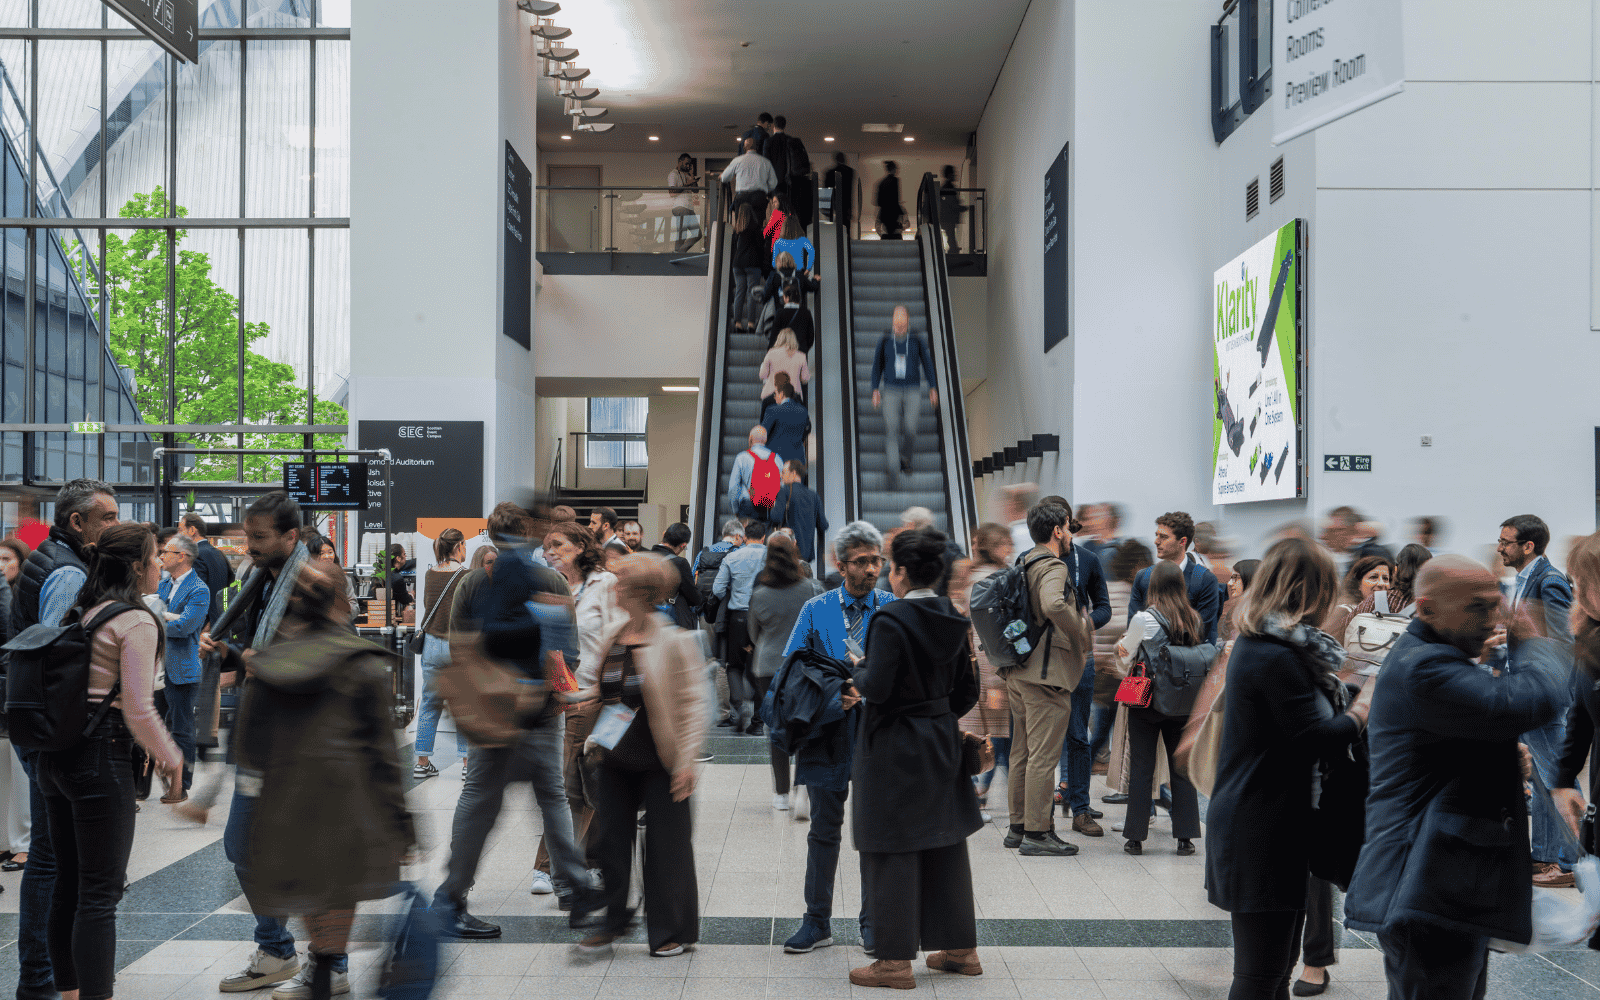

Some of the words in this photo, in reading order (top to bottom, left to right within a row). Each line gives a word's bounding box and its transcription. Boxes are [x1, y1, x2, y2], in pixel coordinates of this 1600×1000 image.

[1286, 27, 1325, 63] Rooms
[1285, 71, 1331, 110] Preview
[1332, 53, 1366, 88] Room
[1216, 266, 1258, 342] Klarity
[398, 426, 424, 438] SEC
[395, 458, 434, 466] Auditorium
